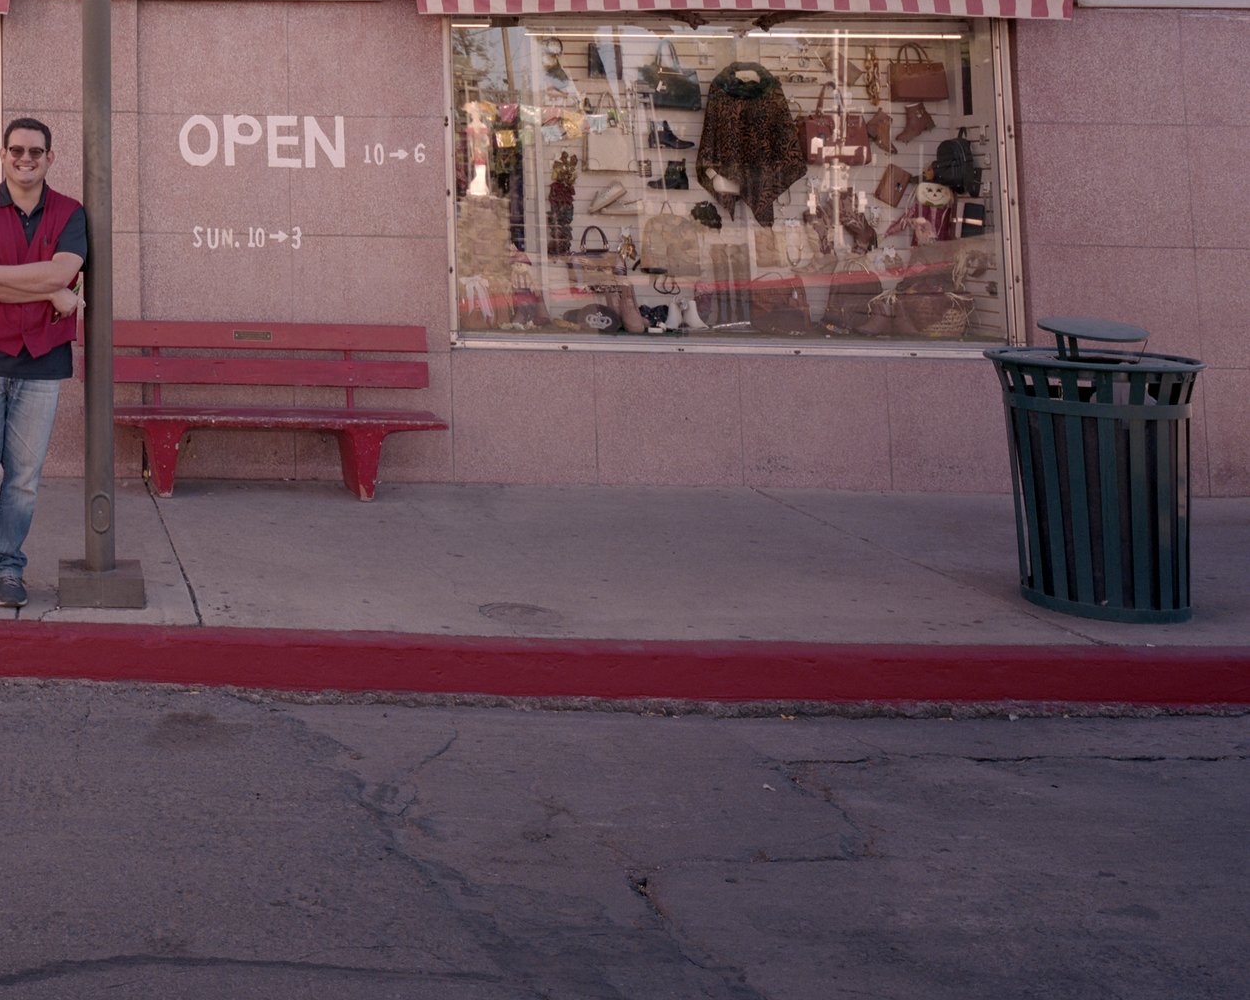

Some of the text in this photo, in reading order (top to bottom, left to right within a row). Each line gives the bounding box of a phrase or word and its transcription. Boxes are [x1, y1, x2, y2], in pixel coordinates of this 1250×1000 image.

[178, 114, 346, 169] OPEN
[363, 143, 385, 166] 10
[192, 226, 241, 249] SUN.
[247, 227, 266, 248] 10
